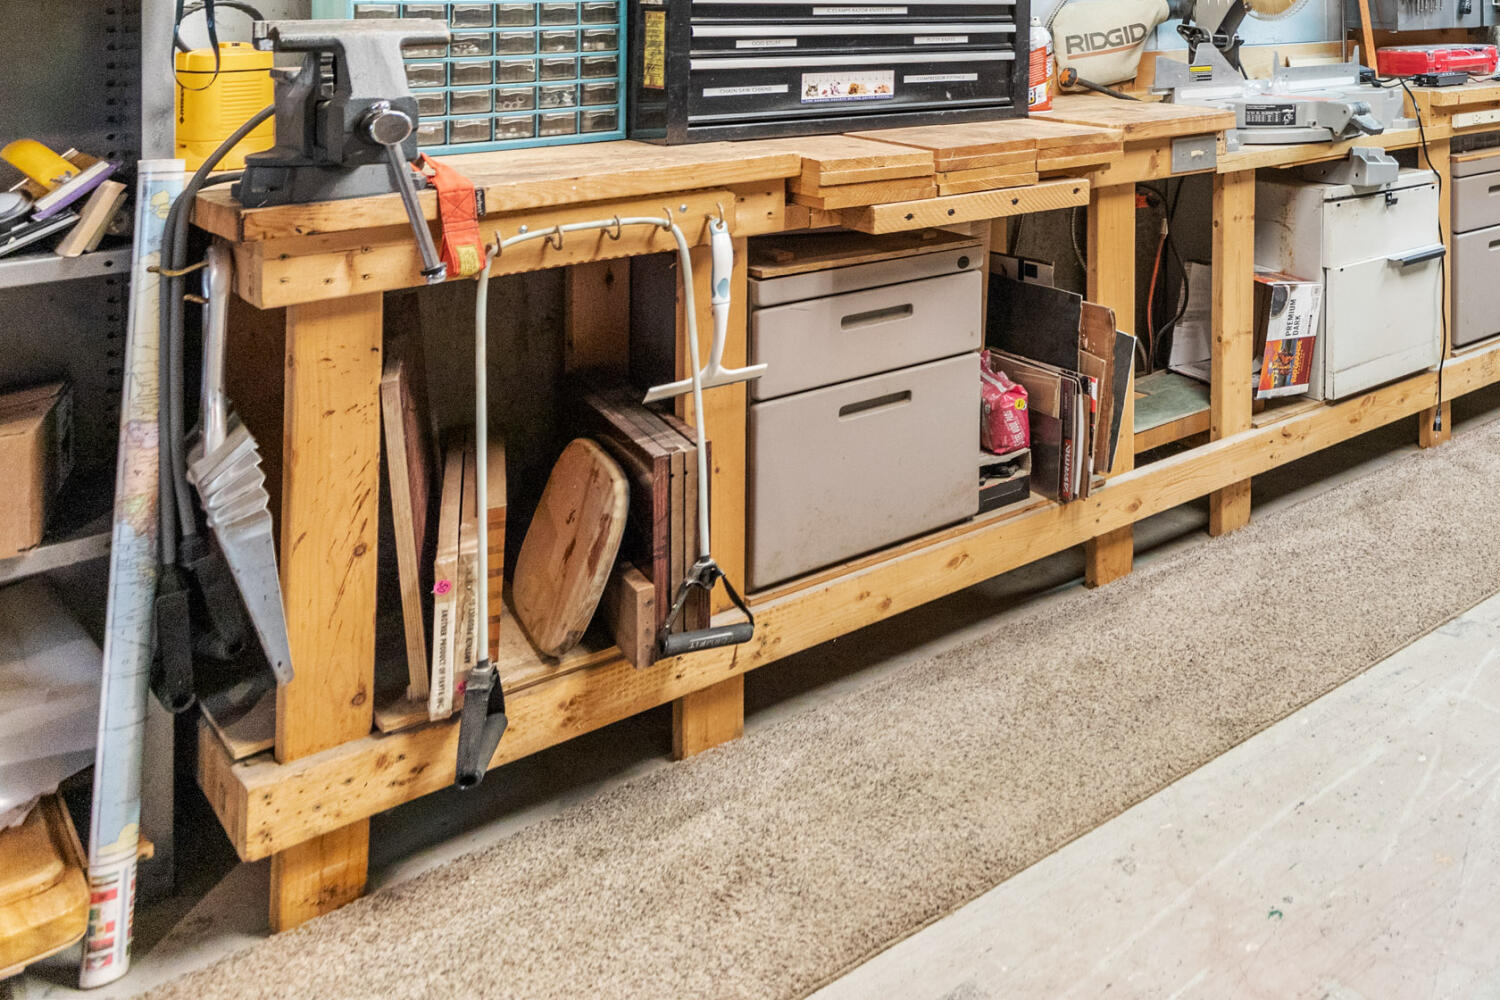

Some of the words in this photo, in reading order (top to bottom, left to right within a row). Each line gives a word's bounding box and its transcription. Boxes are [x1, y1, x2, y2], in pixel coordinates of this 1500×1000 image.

[1065, 23, 1148, 54] RIDGID
[1285, 298, 1297, 337] PREMIUM
[1292, 314, 1301, 336] DARK
[439, 608, 449, 637] ANOTHER
[438, 637, 448, 666] PRODUCT
